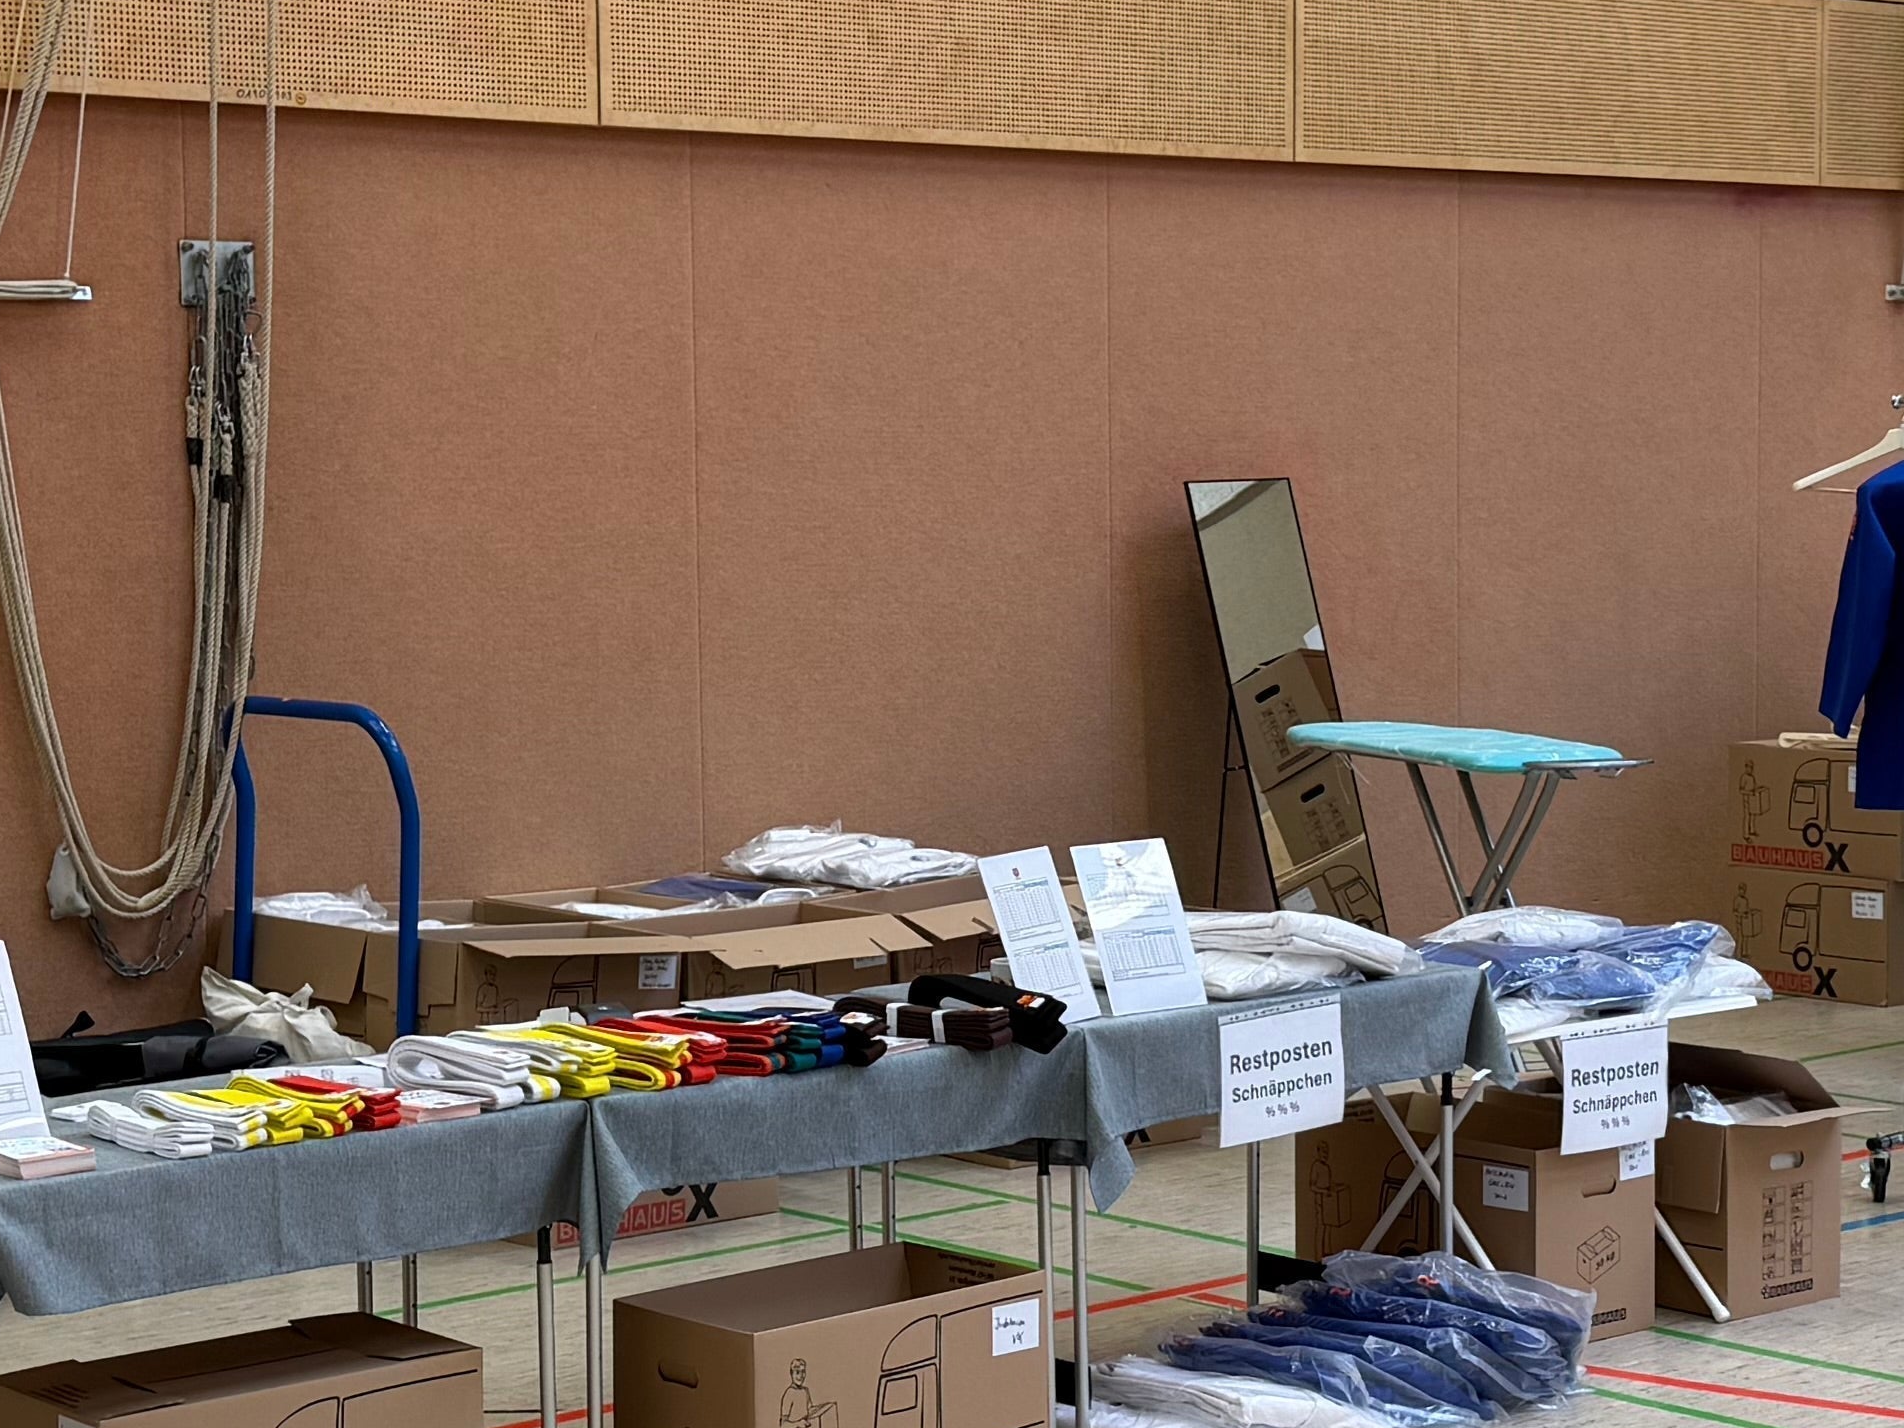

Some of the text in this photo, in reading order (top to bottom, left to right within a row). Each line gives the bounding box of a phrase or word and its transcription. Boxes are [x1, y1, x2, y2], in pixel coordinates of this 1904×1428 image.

[1733, 846, 1823, 868] BAUHAUS
[1230, 1040, 1333, 1075] Restposten
[1232, 1072, 1333, 1103] Schnäppchen
[1570, 1060, 1660, 1088] Restposten
[1572, 1089, 1658, 1114] Schnäppchen
